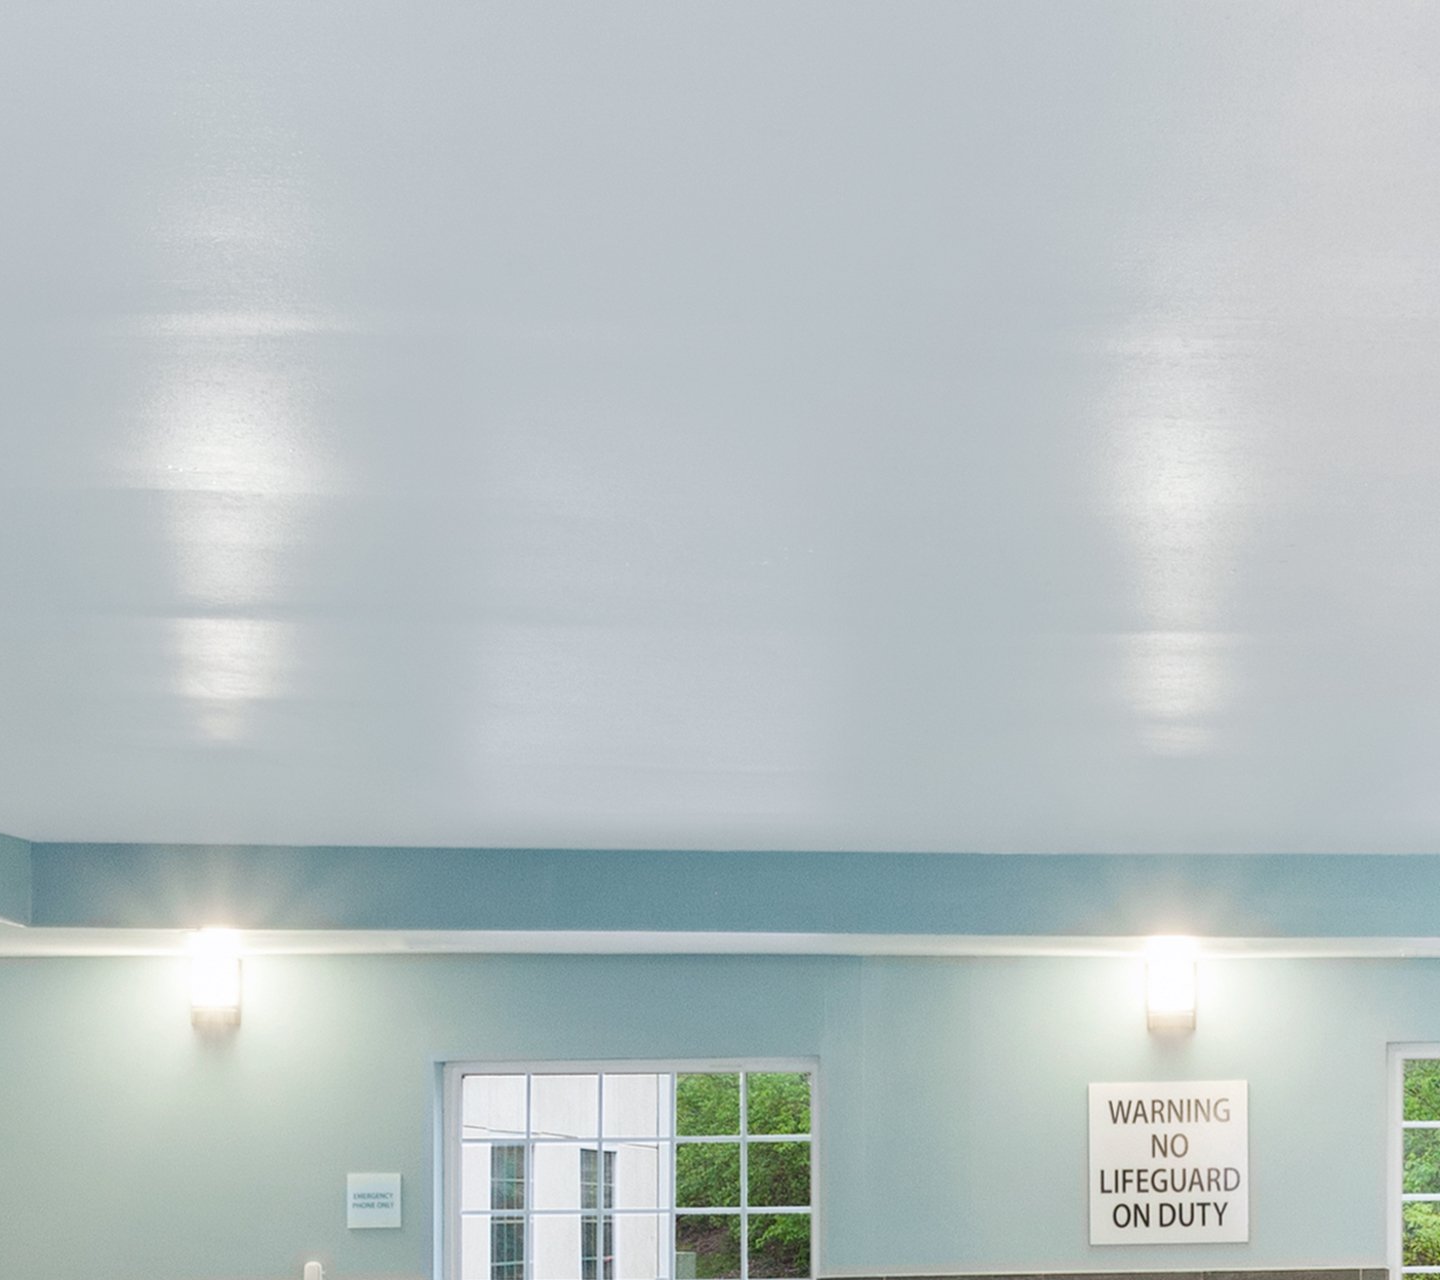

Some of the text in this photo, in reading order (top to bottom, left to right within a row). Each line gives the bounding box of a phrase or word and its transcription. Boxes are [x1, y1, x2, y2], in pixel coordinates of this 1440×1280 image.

[1108, 1098, 1231, 1124] WARNING
[1151, 1133, 1189, 1158] NO
[1100, 1167, 1241, 1194] LIFEGUARD
[353, 1192, 394, 1200] EMERGENCY
[1112, 1202, 1229, 1229] ON DUTY
